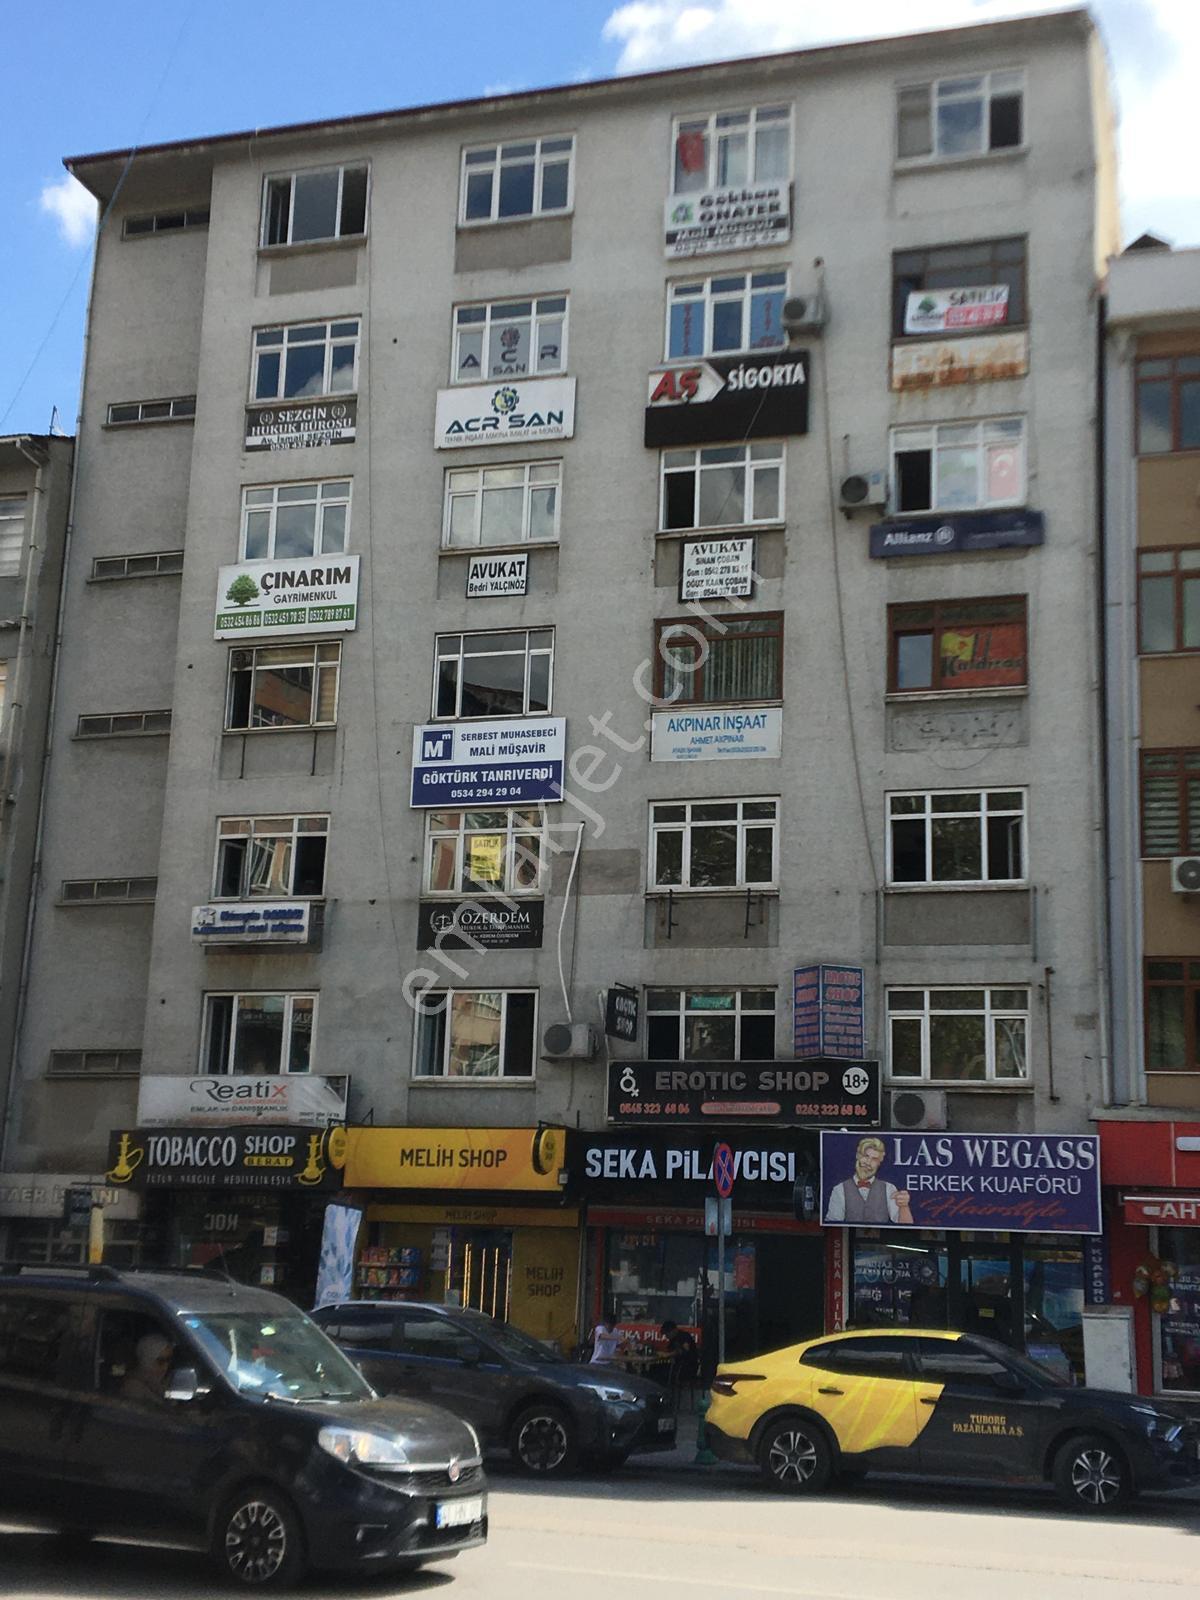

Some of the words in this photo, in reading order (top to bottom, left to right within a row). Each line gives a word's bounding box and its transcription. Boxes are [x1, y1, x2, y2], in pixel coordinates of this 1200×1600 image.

[727, 363, 806, 392] SİGORTA
[278, 406, 327, 423] SEZGİN
[446, 416, 499, 434] ACR
[508, 411, 564, 429] SAN
[251, 423, 297, 436] HUKUK
[300, 417, 352, 432] BÜROSU
[884, 531, 933, 546] Allianz
[690, 541, 747, 556] AVUKAT
[470, 561, 526, 579] AVUKAT
[260, 566, 352, 596] ÇINARIM
[469, 582, 488, 592] Bedri
[489, 578, 525, 593] YALÇINÖZ
[273, 590, 338, 604] GAYRİMENKUL
[667, 716, 721, 732] AKPINAR
[722, 713, 767, 733] İNŞAAT
[461, 732, 498, 741] SERBEST
[500, 727, 557, 739] MUHASEBECİ
[470, 744, 495, 757] MALİ
[498, 742, 546, 757] MÜŞAVİR
[422, 770, 478, 785] GÖKTÜRK
[481, 764, 553, 782] TANRIVERDİ
[451, 789, 474, 798] 0534
[476, 788, 493, 797] 294
[495, 787, 507, 796] 29
[509, 787, 521, 795] 04
[461, 910, 530, 925] ÖZERDEM
[655, 1071, 746, 1091] EROTIC
[758, 1071, 829, 1091] SHOP
[845, 1073, 869, 1089] 18+
[147, 1136, 236, 1167] TOBACCO
[244, 1136, 296, 1155] SHOP
[400, 1145, 454, 1168] MELİH
[458, 1149, 508, 1168] SHOP
[893, 1138, 953, 1167] LAS
[962, 1139, 1095, 1170] WEGASS
[585, 1149, 658, 1179] SEKA
[906, 1174, 974, 1192] ERKEK
[980, 1175, 1082, 1195] KUAFÖRÜ
[528, 1283, 561, 1297] SHOP
[970, 1414, 1006, 1426] TUBORG
[952, 1423, 1007, 1436] PAZARLAMA
